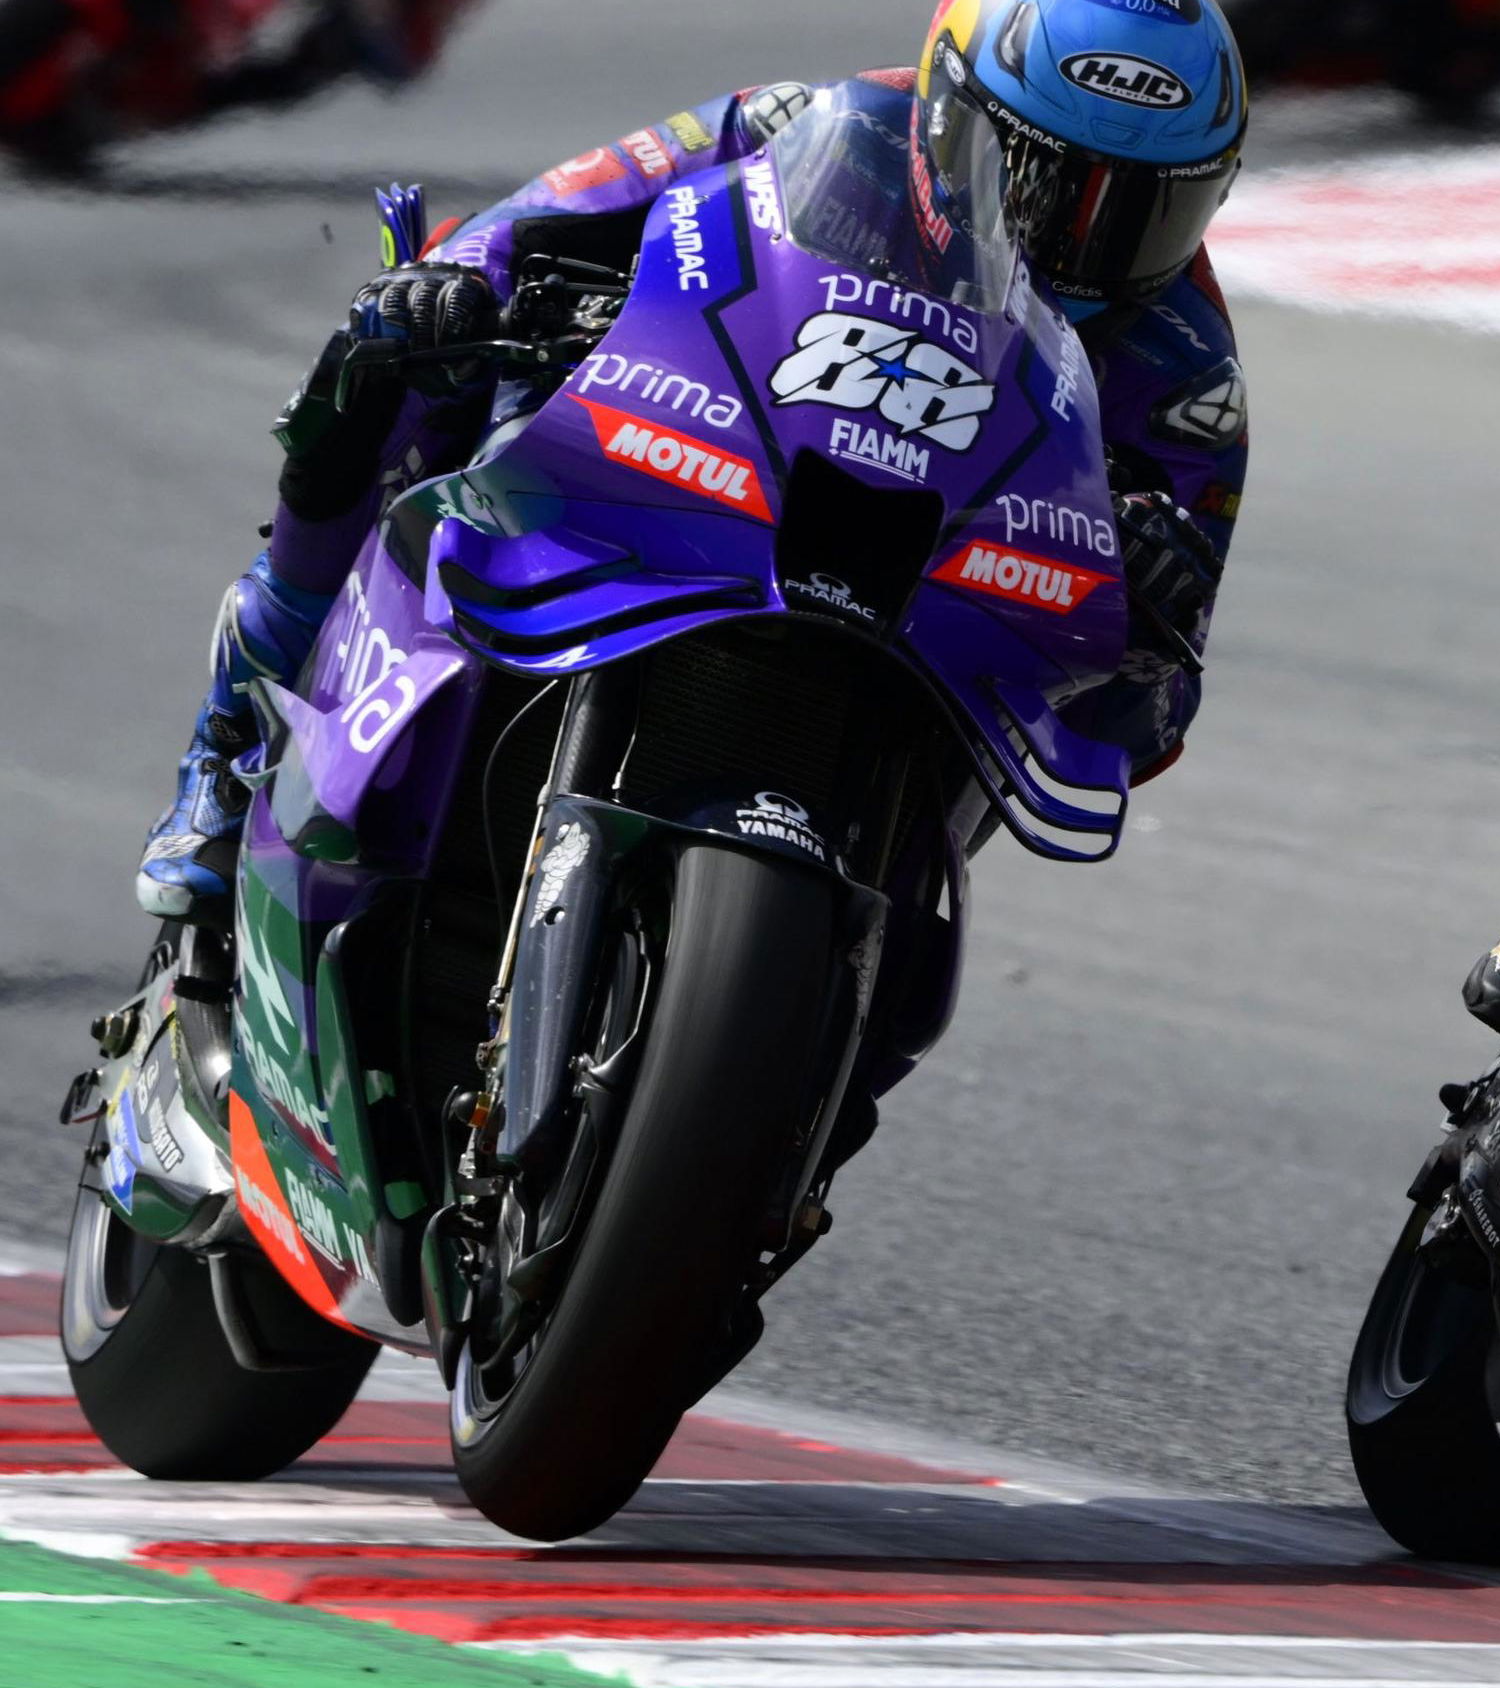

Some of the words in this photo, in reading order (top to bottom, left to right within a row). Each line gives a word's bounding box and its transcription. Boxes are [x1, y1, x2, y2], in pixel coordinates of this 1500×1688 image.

[1077, 60, 1179, 102] HJC
[1000, 106, 1066, 154] PRAMAC
[744, 162, 782, 234] WRS
[1169, 157, 1223, 178] PRAMAC
[665, 185, 708, 291] PRAMAC
[818, 274, 979, 355] prima
[577, 352, 743, 429] prima
[768, 318, 997, 453] 88
[606, 422, 754, 501] MOTUL
[829, 417, 931, 479] FIAMM
[995, 492, 1116, 557] prima
[784, 577, 876, 620] PRAMAC
[959, 544, 1074, 608] MOTUL
[737, 820, 825, 861] YAMAHA
